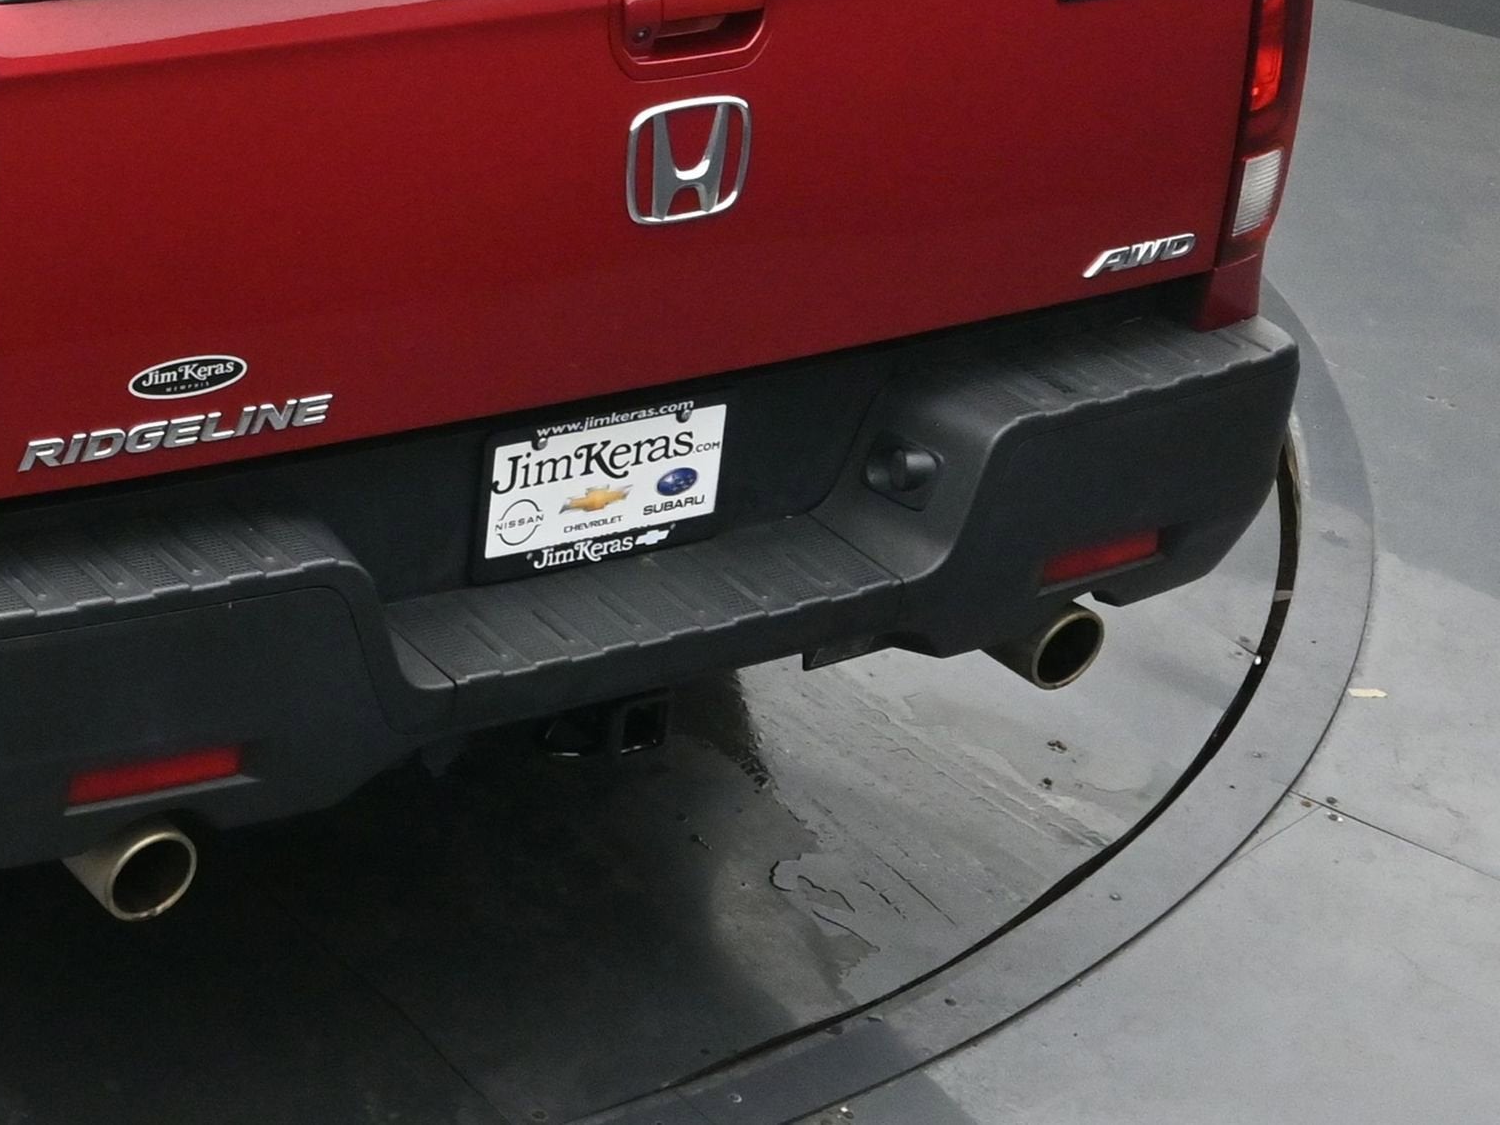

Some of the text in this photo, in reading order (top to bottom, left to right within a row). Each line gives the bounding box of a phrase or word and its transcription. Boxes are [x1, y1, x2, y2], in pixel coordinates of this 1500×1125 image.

[1083, 232, 1196, 279] AWD
[16, 393, 334, 473] RIDGELINE
[536, 399, 695, 438] www.jimkeras.com
[643, 495, 705, 516] SUBARU
[495, 513, 545, 531] NISSAN
[563, 515, 624, 534] CHEVROLET
